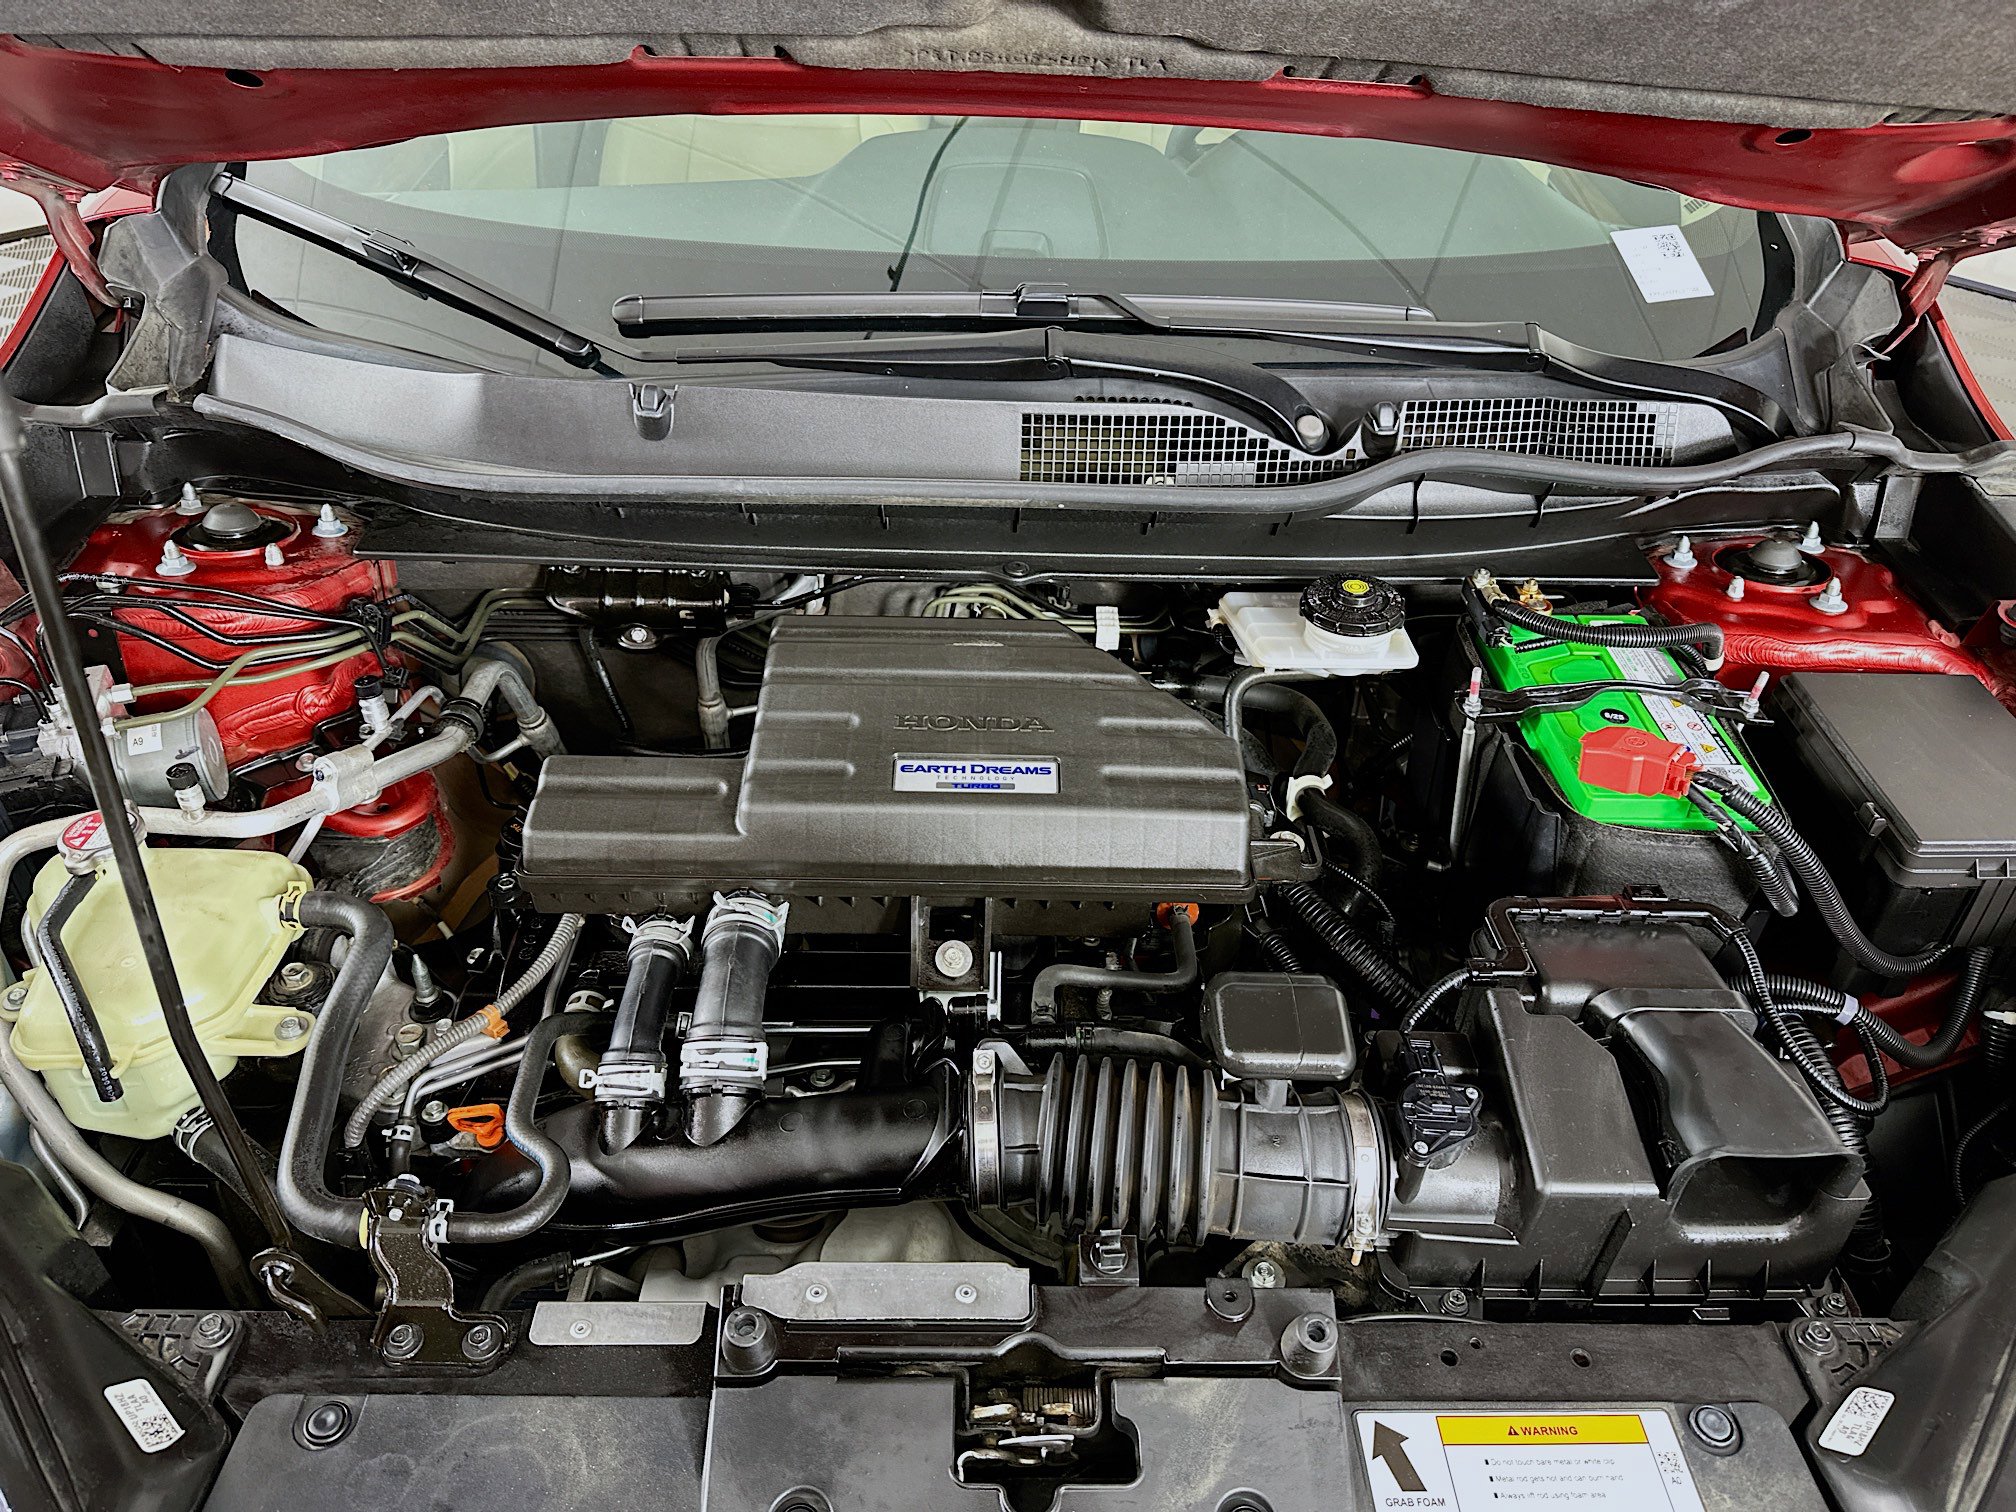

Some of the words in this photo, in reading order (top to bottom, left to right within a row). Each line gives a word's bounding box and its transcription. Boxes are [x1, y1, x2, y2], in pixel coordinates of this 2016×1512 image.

[893, 714, 1055, 732] HONDA
[900, 764, 966, 774] EARTH
[970, 764, 1052, 775] DREAMS
[1520, 1426, 1578, 1436] WARNING
[1385, 1497, 1415, 1507] GRAB
[1416, 1497, 1446, 1507] FOAM
